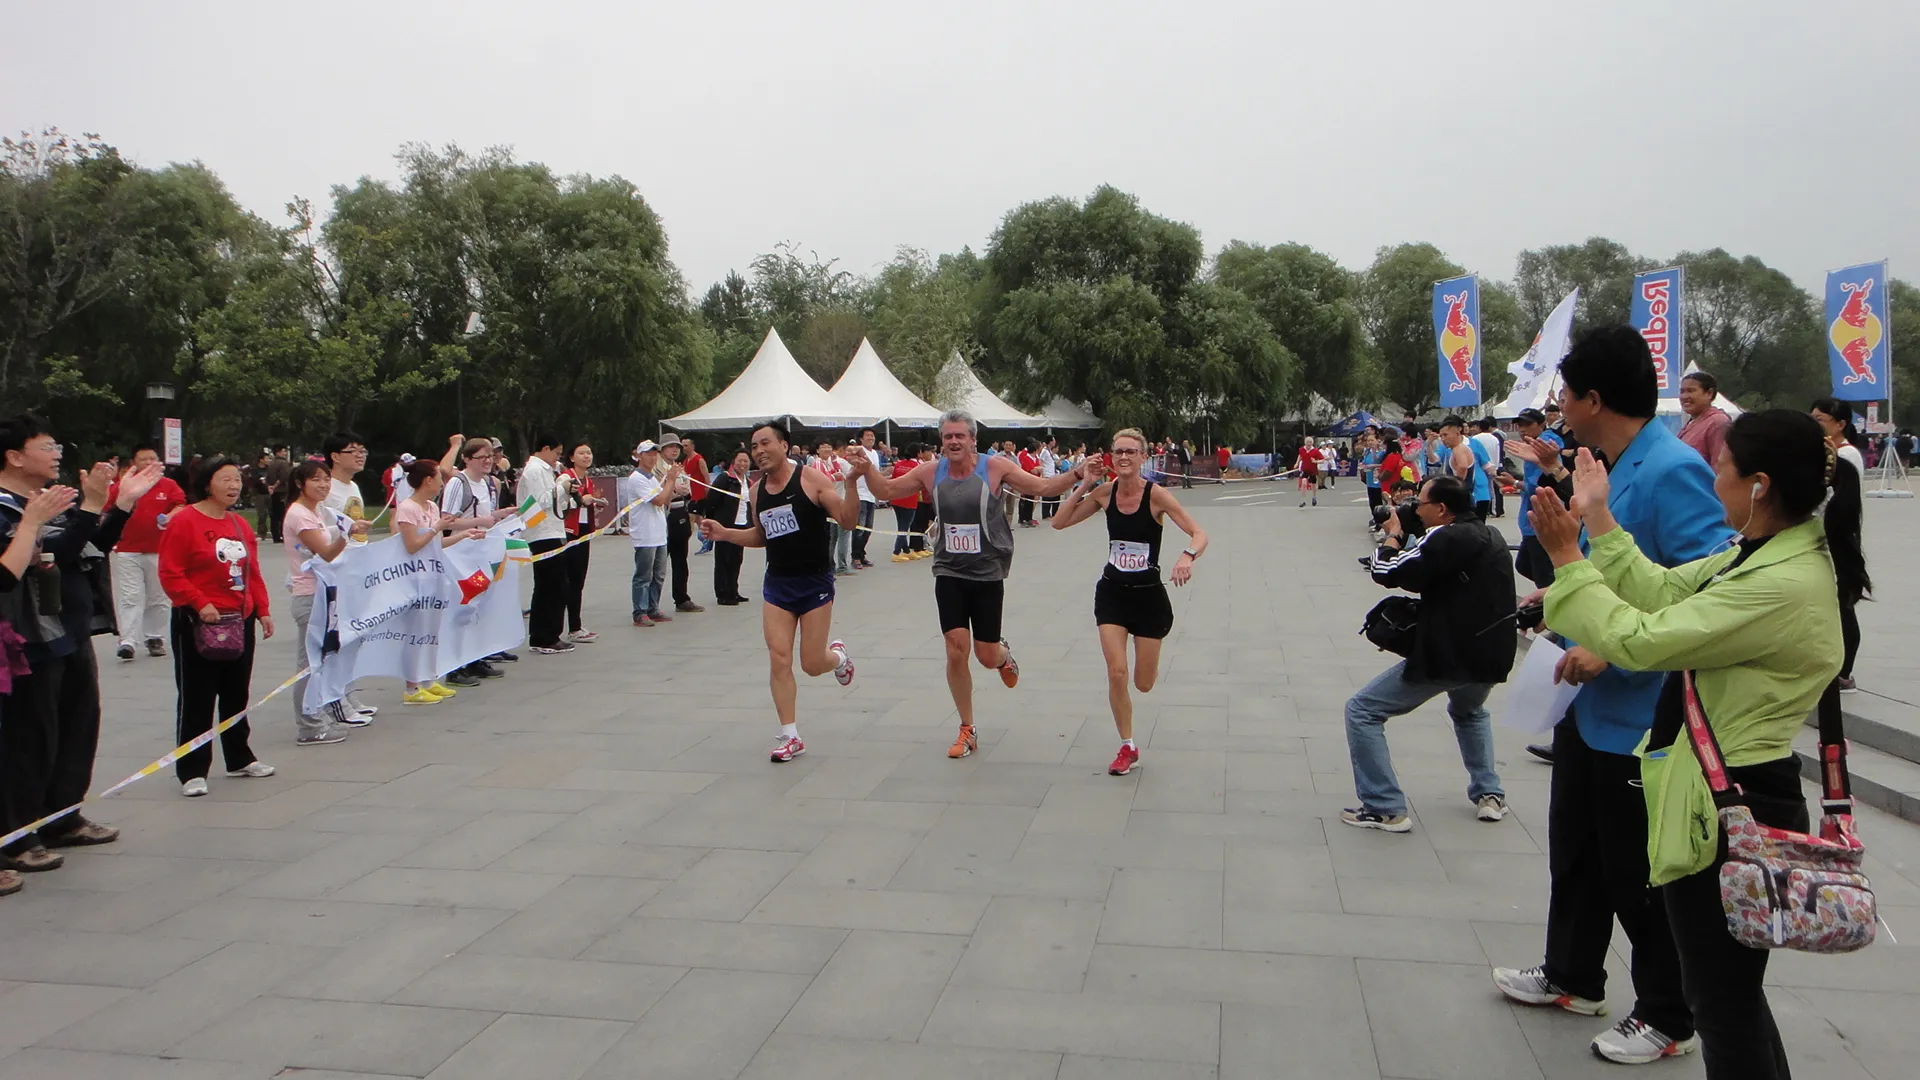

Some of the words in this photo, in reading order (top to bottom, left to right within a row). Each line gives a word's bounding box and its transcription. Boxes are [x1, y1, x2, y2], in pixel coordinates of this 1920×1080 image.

[764, 513, 796, 537] 2086
[947, 534, 977, 552] 1001
[382, 559, 427, 581] CHINA
[1114, 551, 1146, 569] 1050
